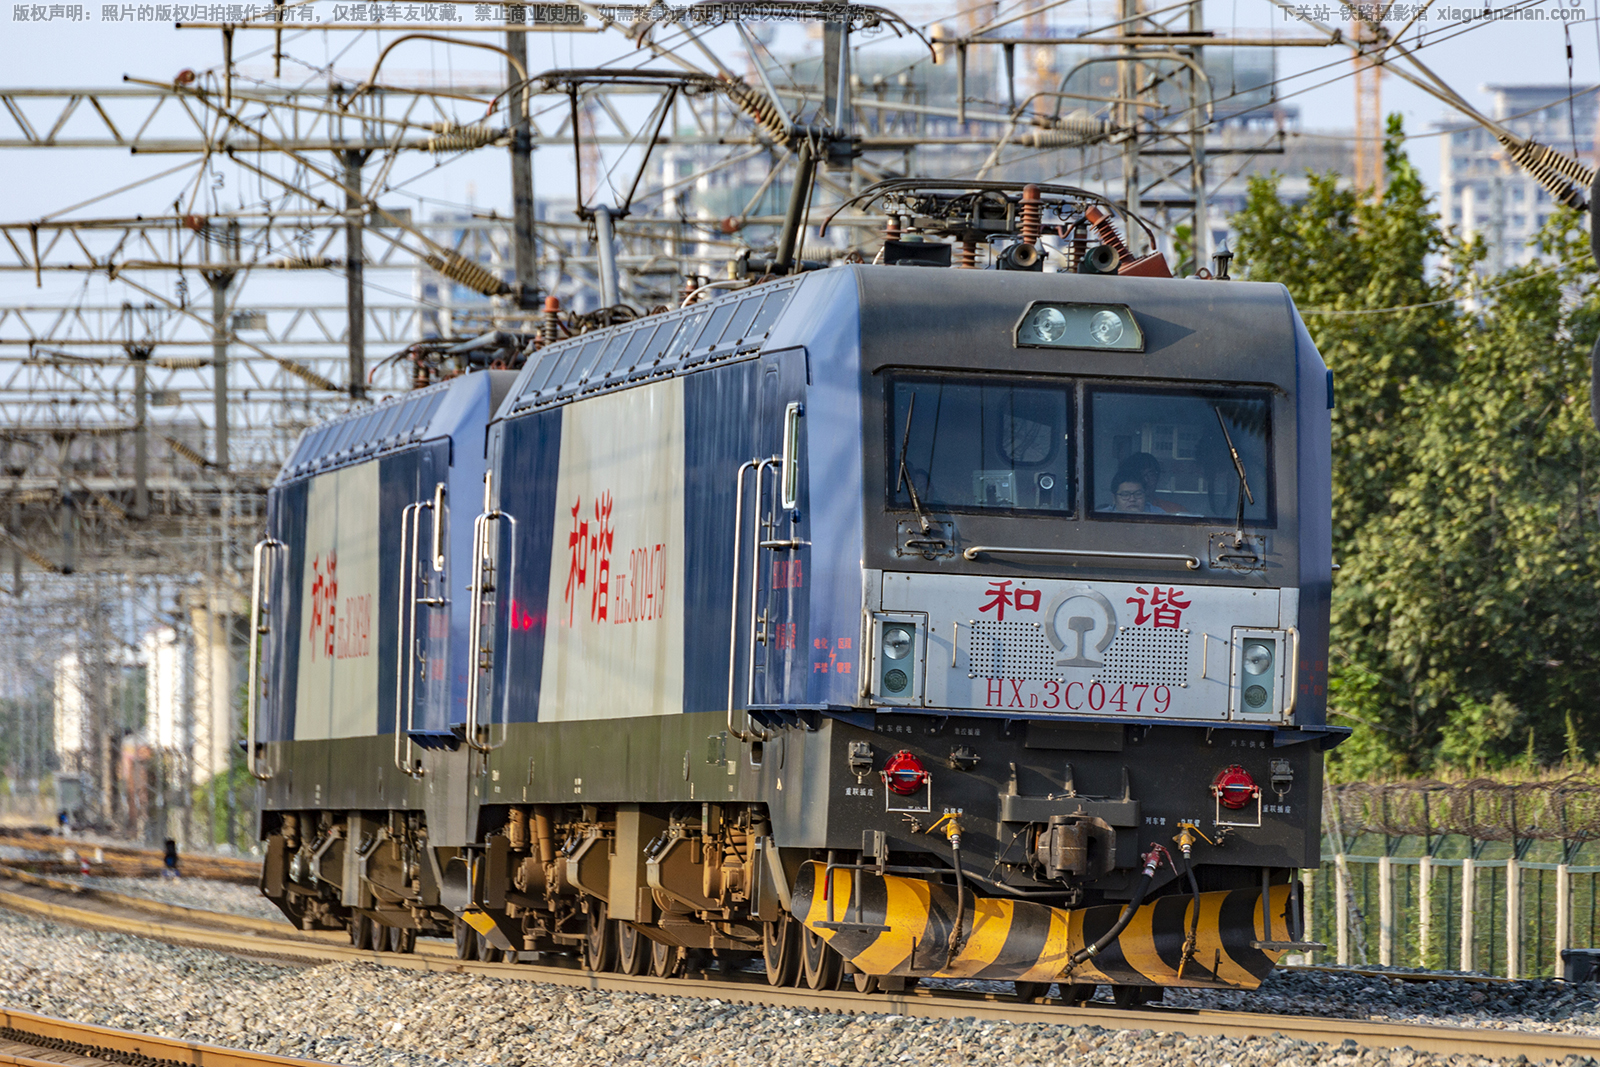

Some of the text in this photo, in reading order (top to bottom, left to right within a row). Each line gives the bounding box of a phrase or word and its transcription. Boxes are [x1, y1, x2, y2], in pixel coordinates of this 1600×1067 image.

[565, 488, 615, 629] 和谐
[978, 579, 1193, 630] 和 谐
[985, 677, 1173, 714] HXD3C0479
[1145, 816, 1166, 826] 列车管
